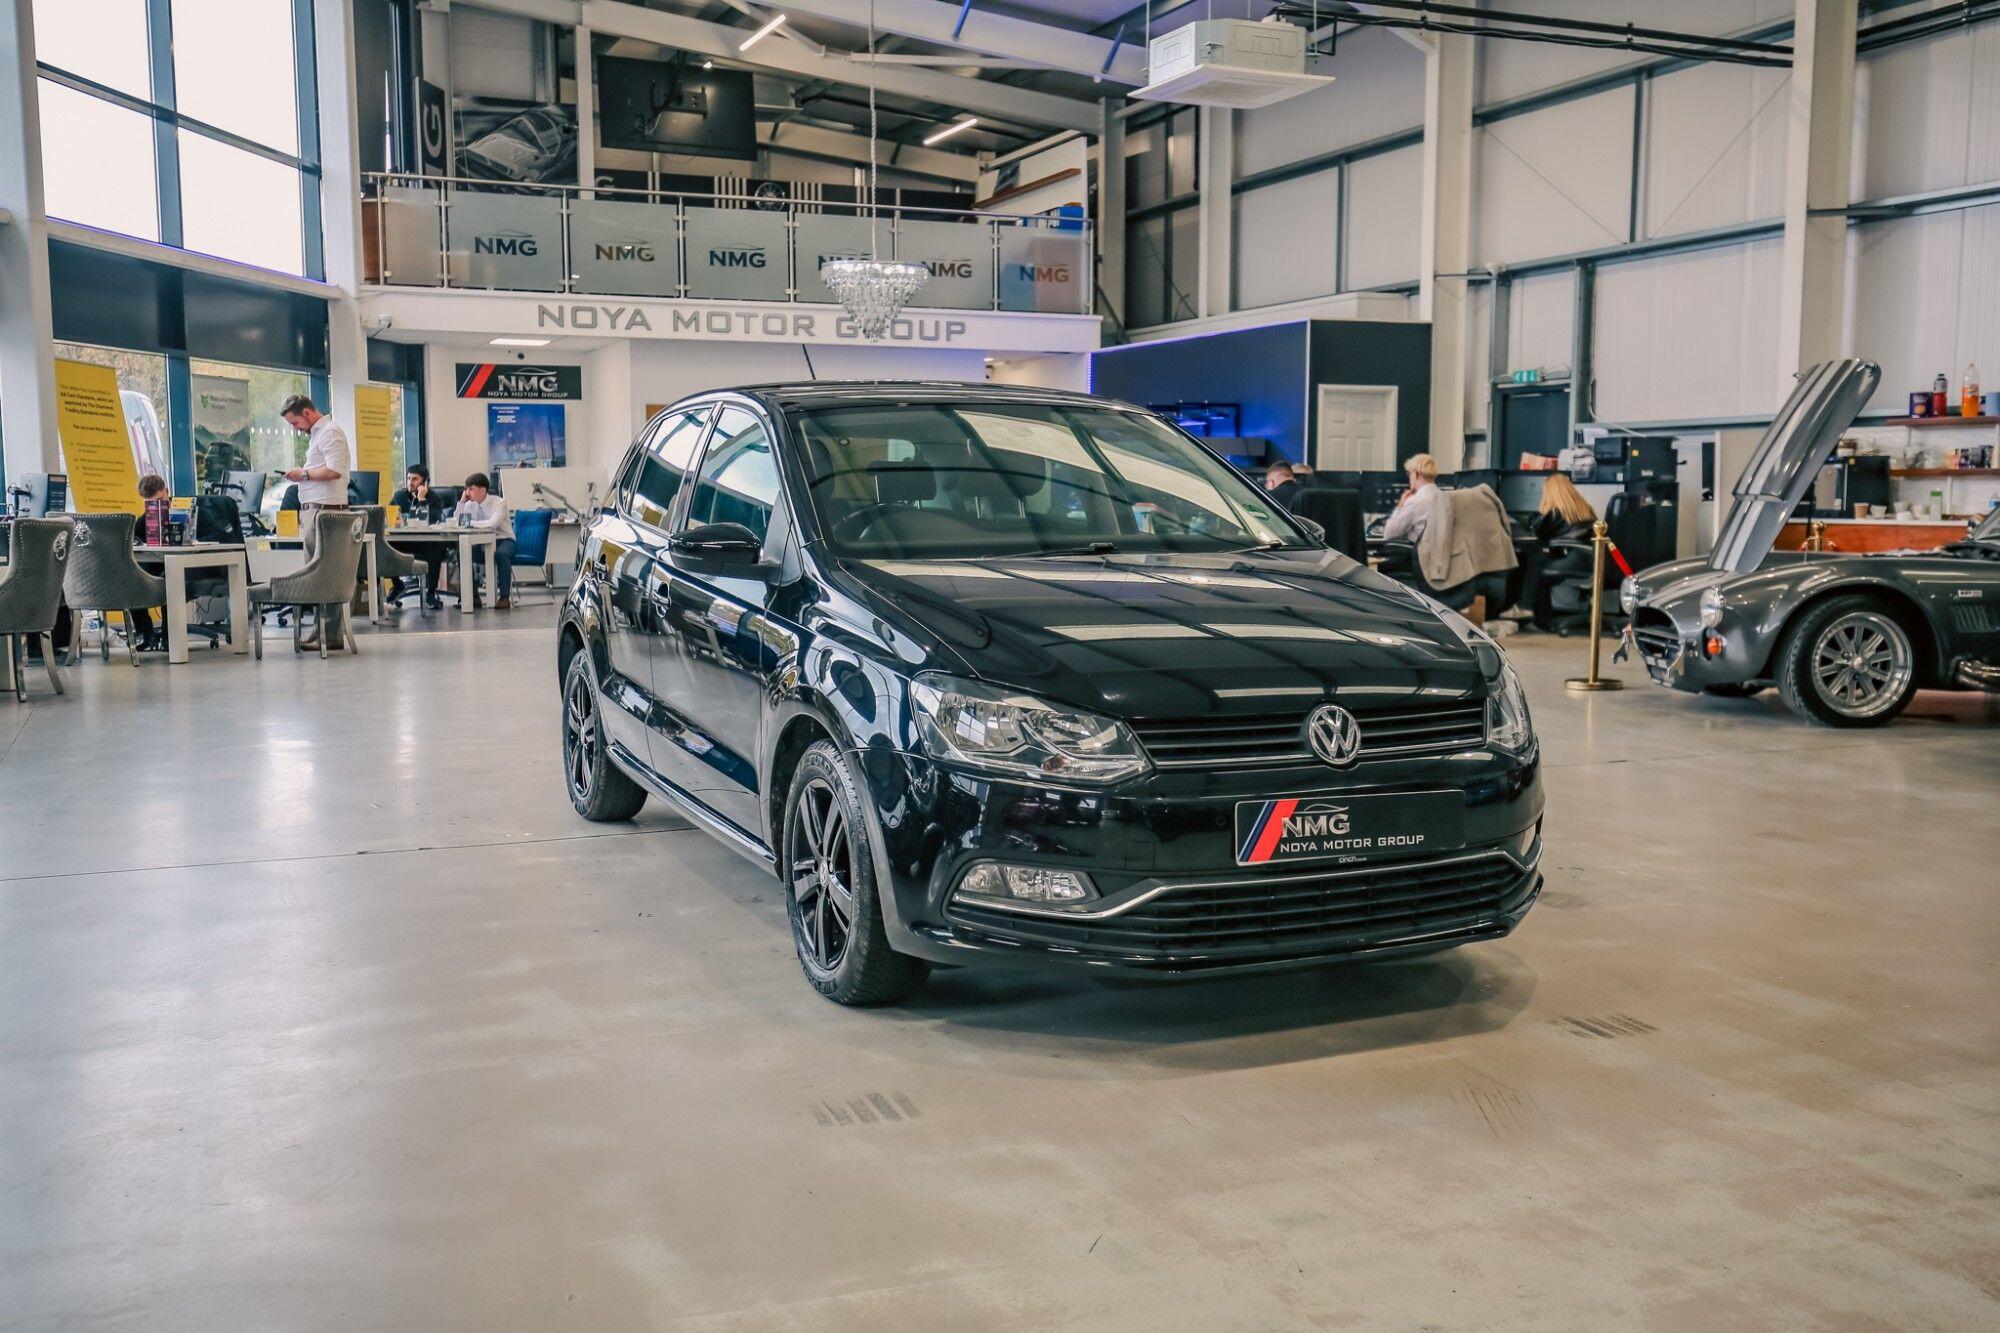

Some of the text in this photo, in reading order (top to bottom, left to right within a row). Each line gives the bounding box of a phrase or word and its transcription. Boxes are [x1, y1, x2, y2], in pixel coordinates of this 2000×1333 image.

[474, 237, 538, 256] NMG
[595, 244, 655, 262] NMG
[709, 250, 766, 268] NMG
[1020, 266, 1069, 283] NMG
[537, 304, 966, 342] NOYA MOTOR GOUP
[498, 375, 558, 392] NMG
[1281, 813, 1350, 838] NMG
[1280, 834, 1425, 853] NOYA MOTOR GROUP
